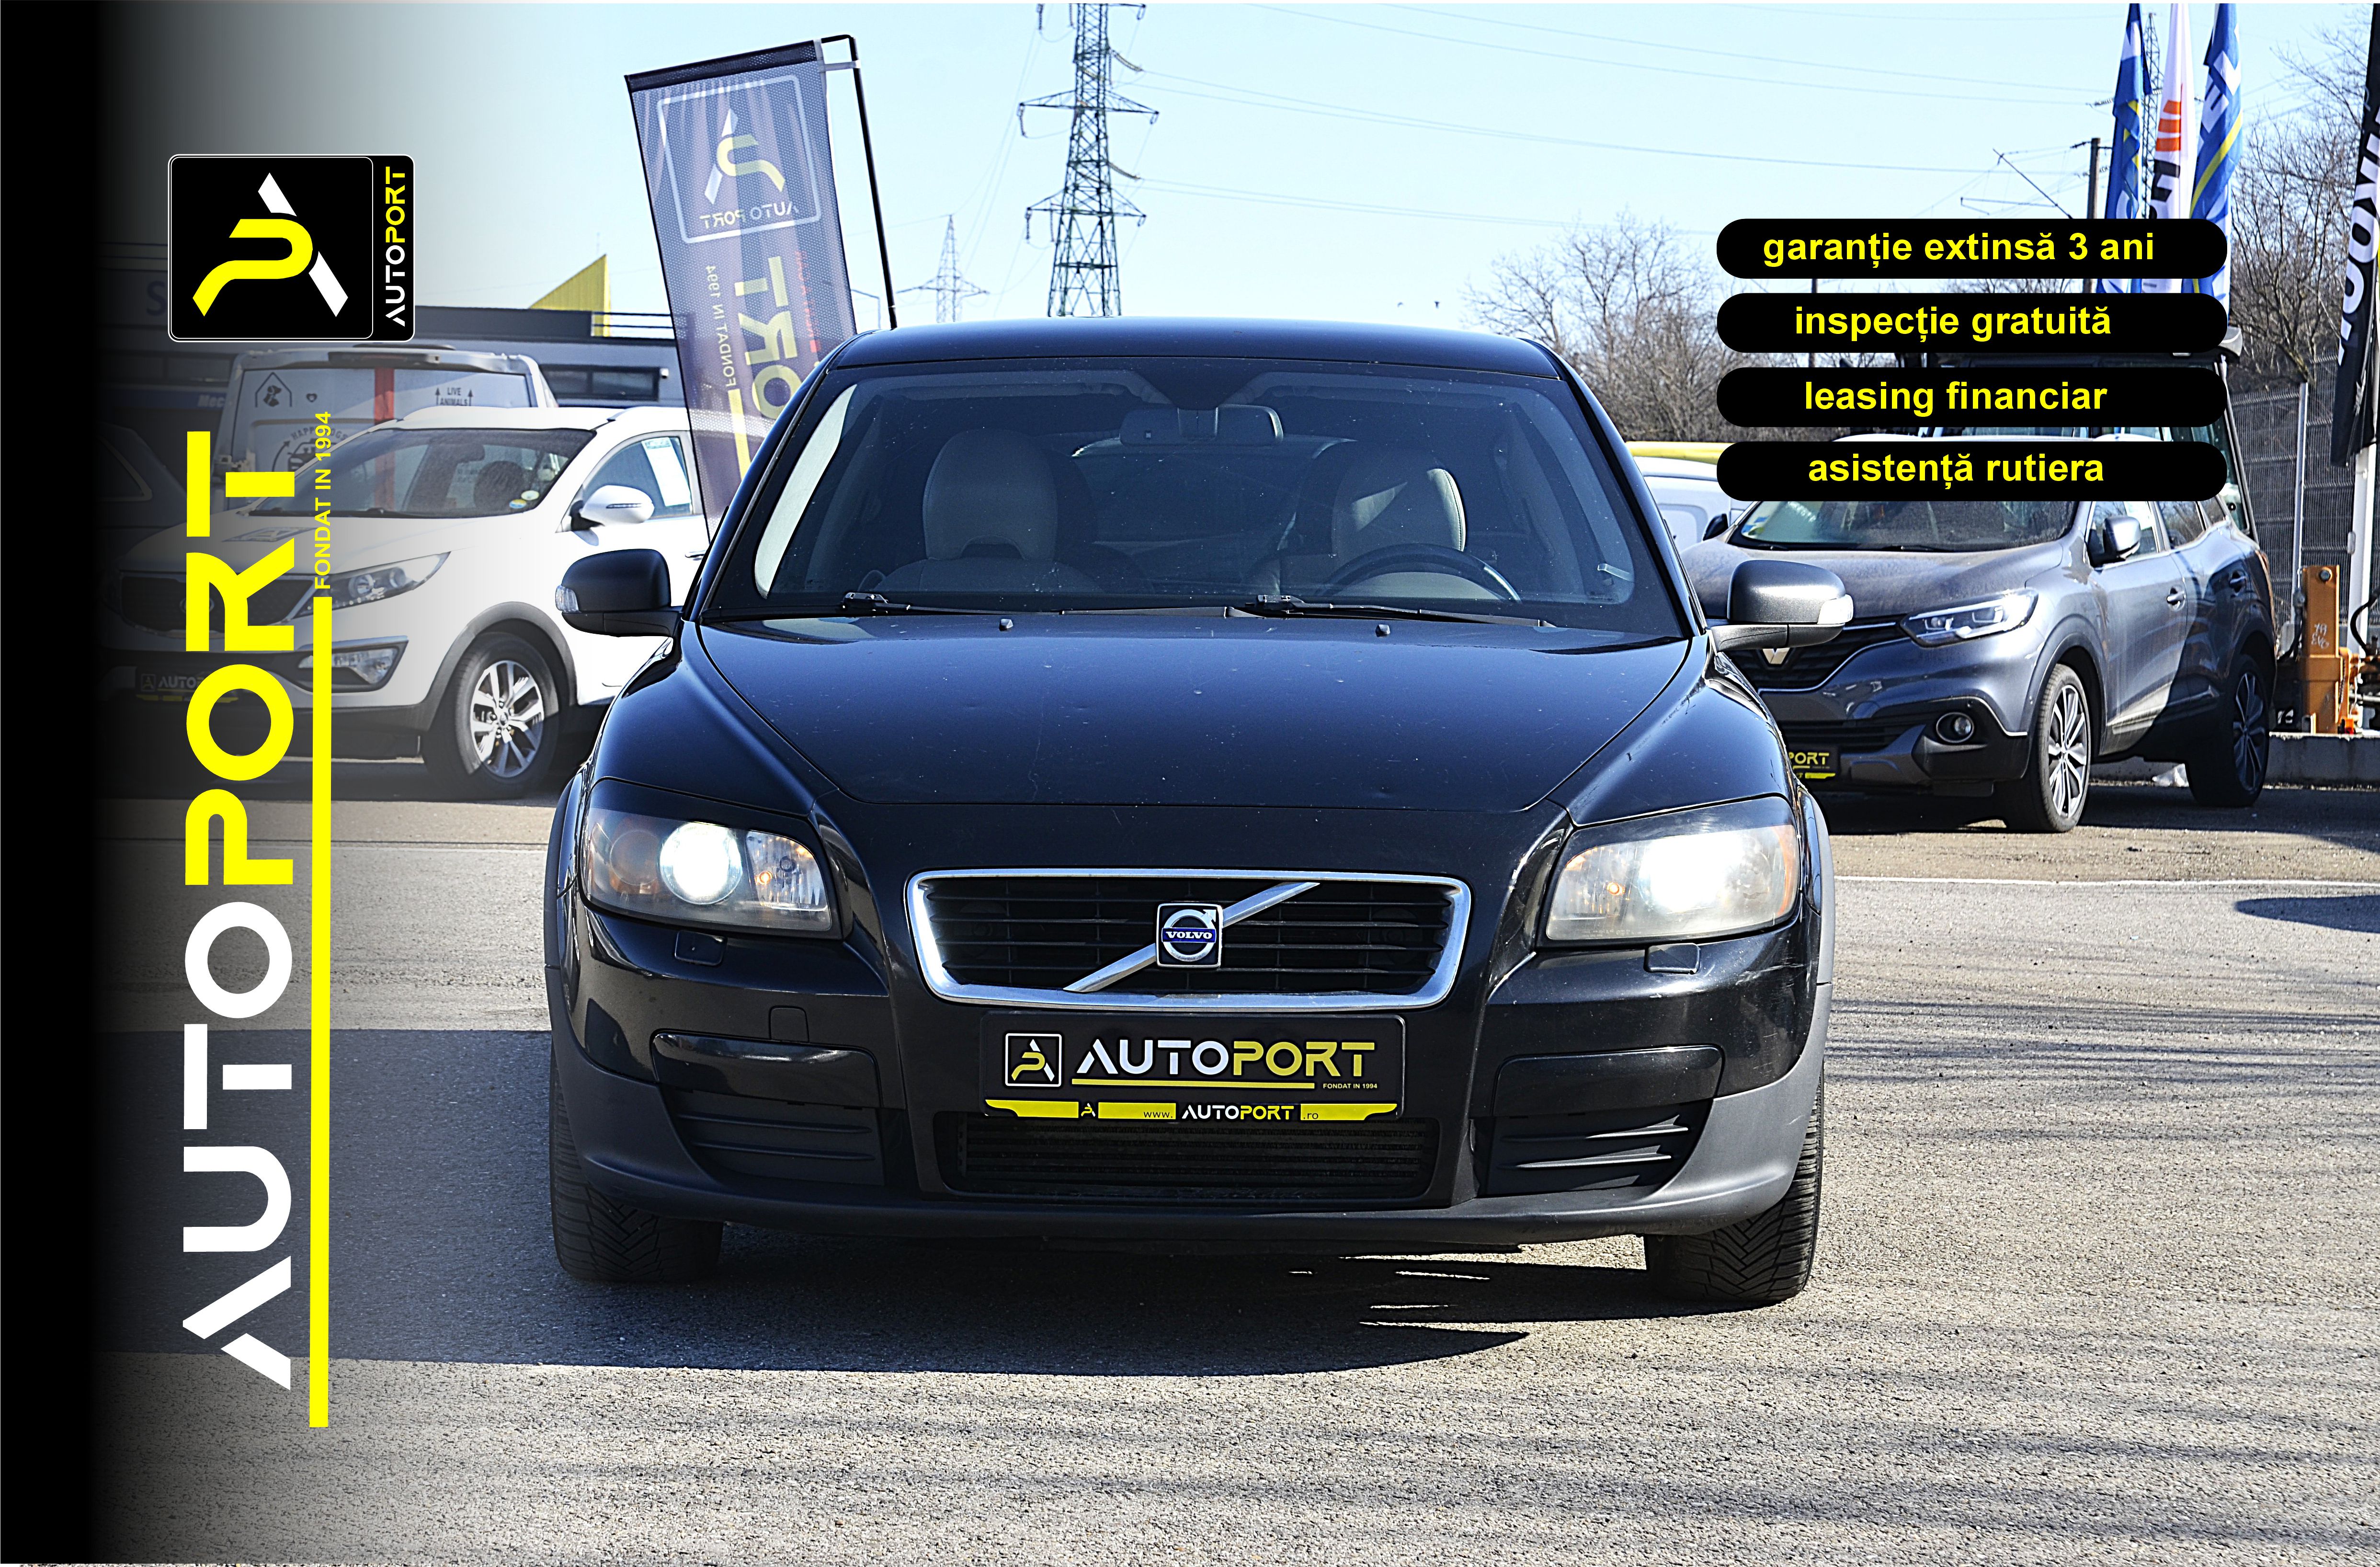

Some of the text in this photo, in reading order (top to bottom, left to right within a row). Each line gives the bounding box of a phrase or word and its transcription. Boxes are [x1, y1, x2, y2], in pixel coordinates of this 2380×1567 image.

[447, 387, 461, 396] LIVE
[1166, 931, 1212, 939] VOLVO
[1076, 1039, 1375, 1078] AUTOPORT
[1182, 1105, 1294, 1120] AUTOPORT
